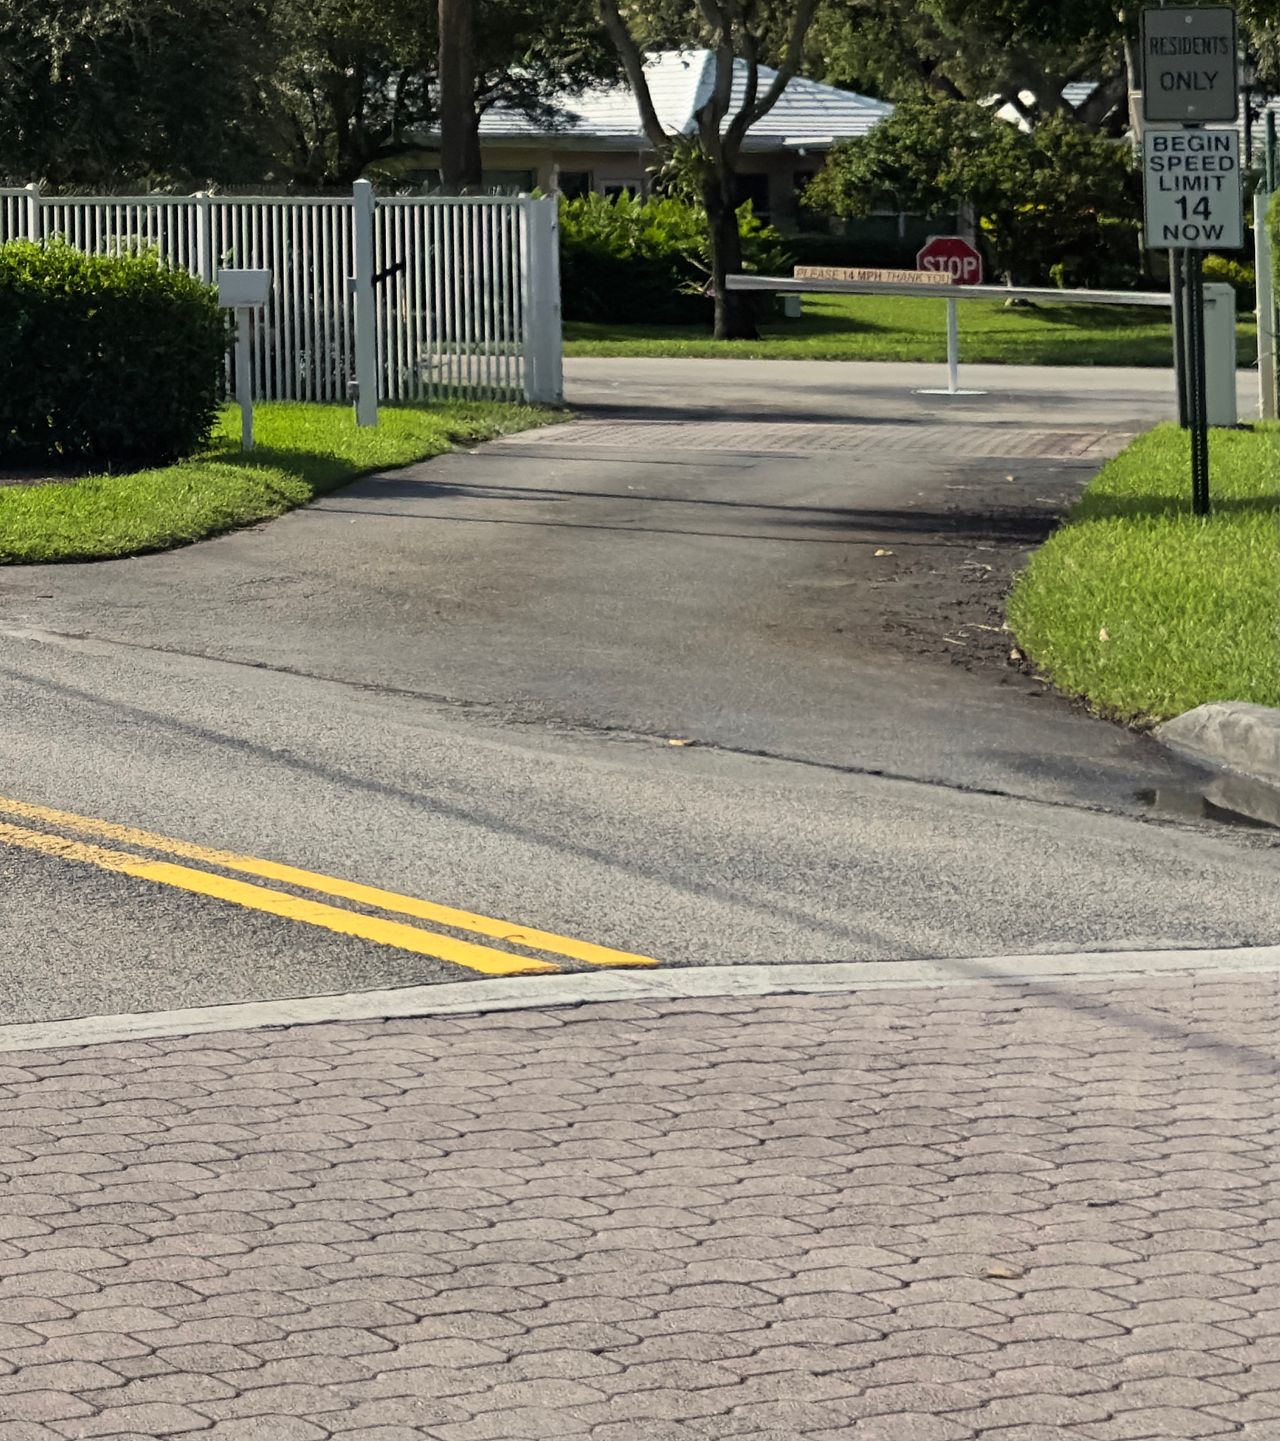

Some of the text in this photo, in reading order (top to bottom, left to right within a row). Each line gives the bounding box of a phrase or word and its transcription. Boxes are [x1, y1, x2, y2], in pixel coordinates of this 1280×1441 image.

[1149, 36, 1229, 56] RESIDENTS
[1160, 71, 1218, 91] ONLY
[1153, 135, 1230, 152] BEGIN
[1150, 155, 1234, 172] SPEED
[1160, 175, 1226, 192] LIMIT
[1175, 195, 1212, 221] 14
[1163, 224, 1224, 241] NOW
[796, 268, 839, 280] PLEASE
[842, 270, 854, 280] 14
[858, 271, 882, 281] MPH
[887, 271, 924, 283] THANK
[923, 256, 977, 279] STOP
